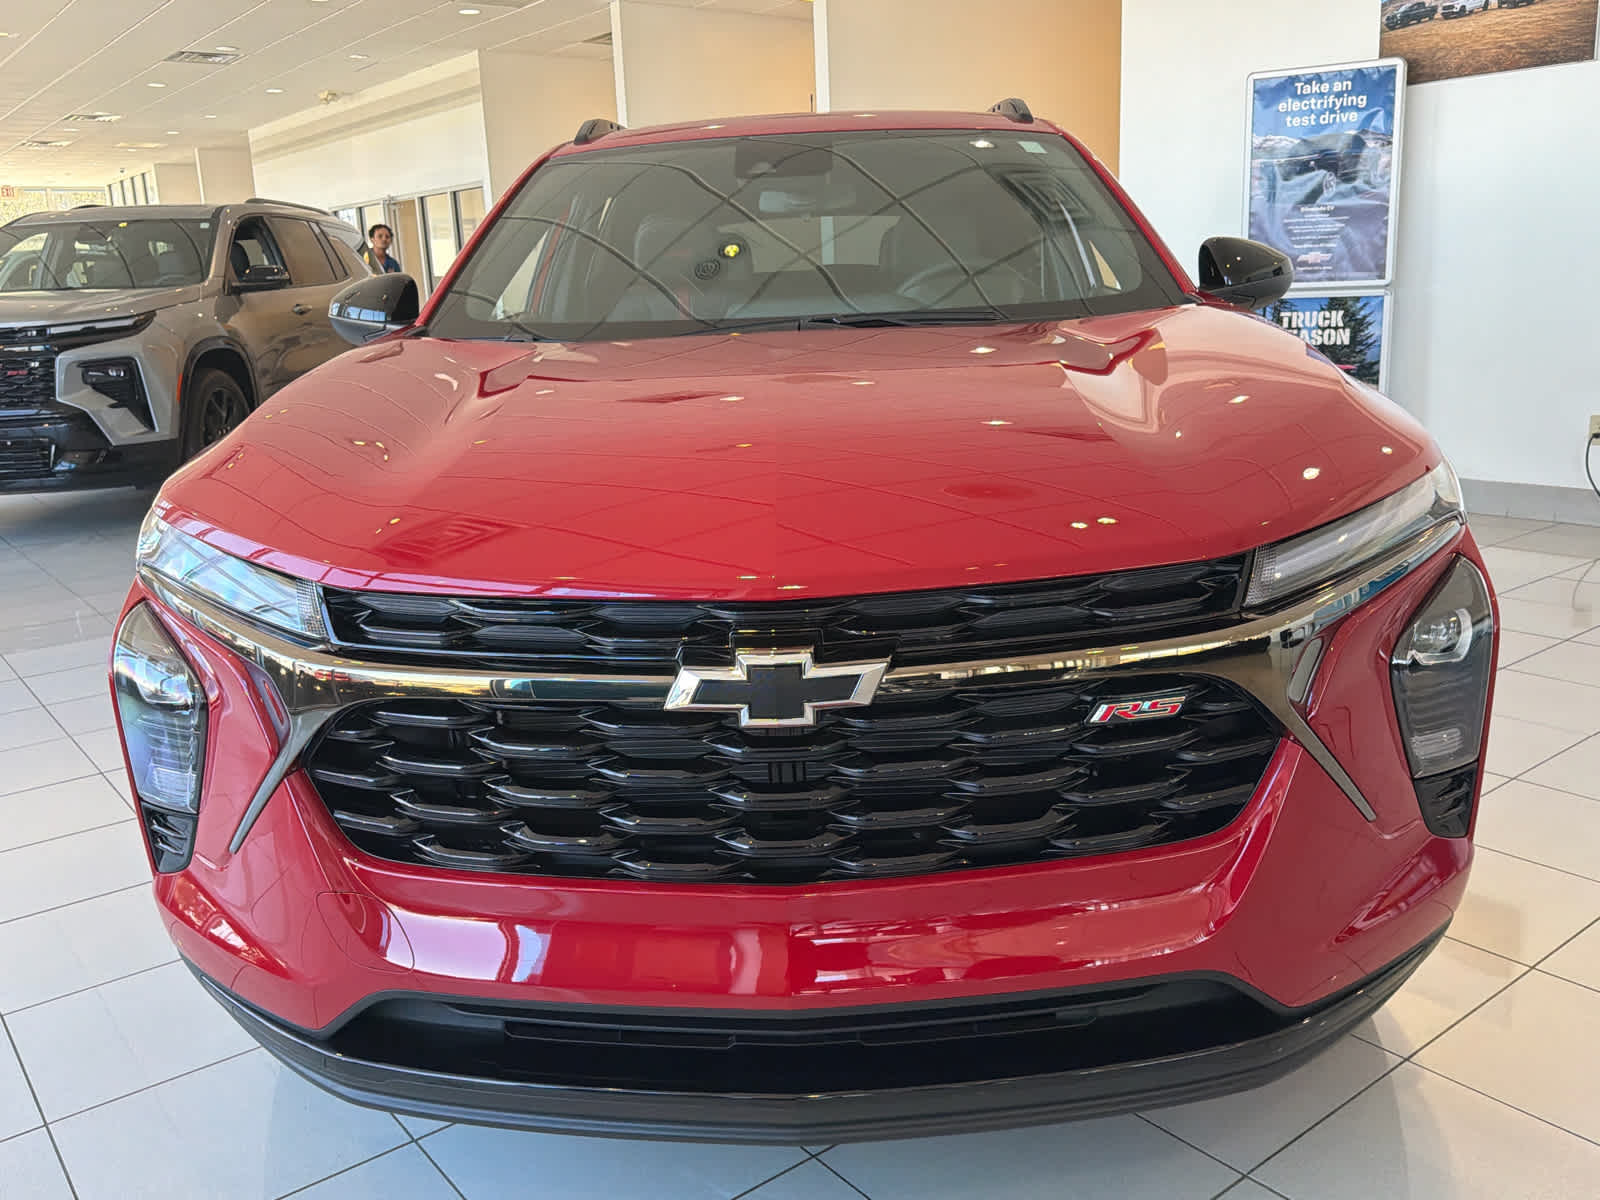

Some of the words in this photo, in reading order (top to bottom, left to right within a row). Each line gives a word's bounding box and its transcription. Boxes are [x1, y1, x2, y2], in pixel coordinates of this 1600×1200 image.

[1294, 80, 1330, 95] Take
[1333, 80, 1352, 92] an
[1278, 94, 1367, 112] electrifying
[1286, 113, 1316, 127] test
[1319, 110, 1358, 125] drive
[1279, 310, 1345, 328] TRUCK
[1287, 328, 1351, 346] ASON
[1089, 696, 1186, 722] RS
